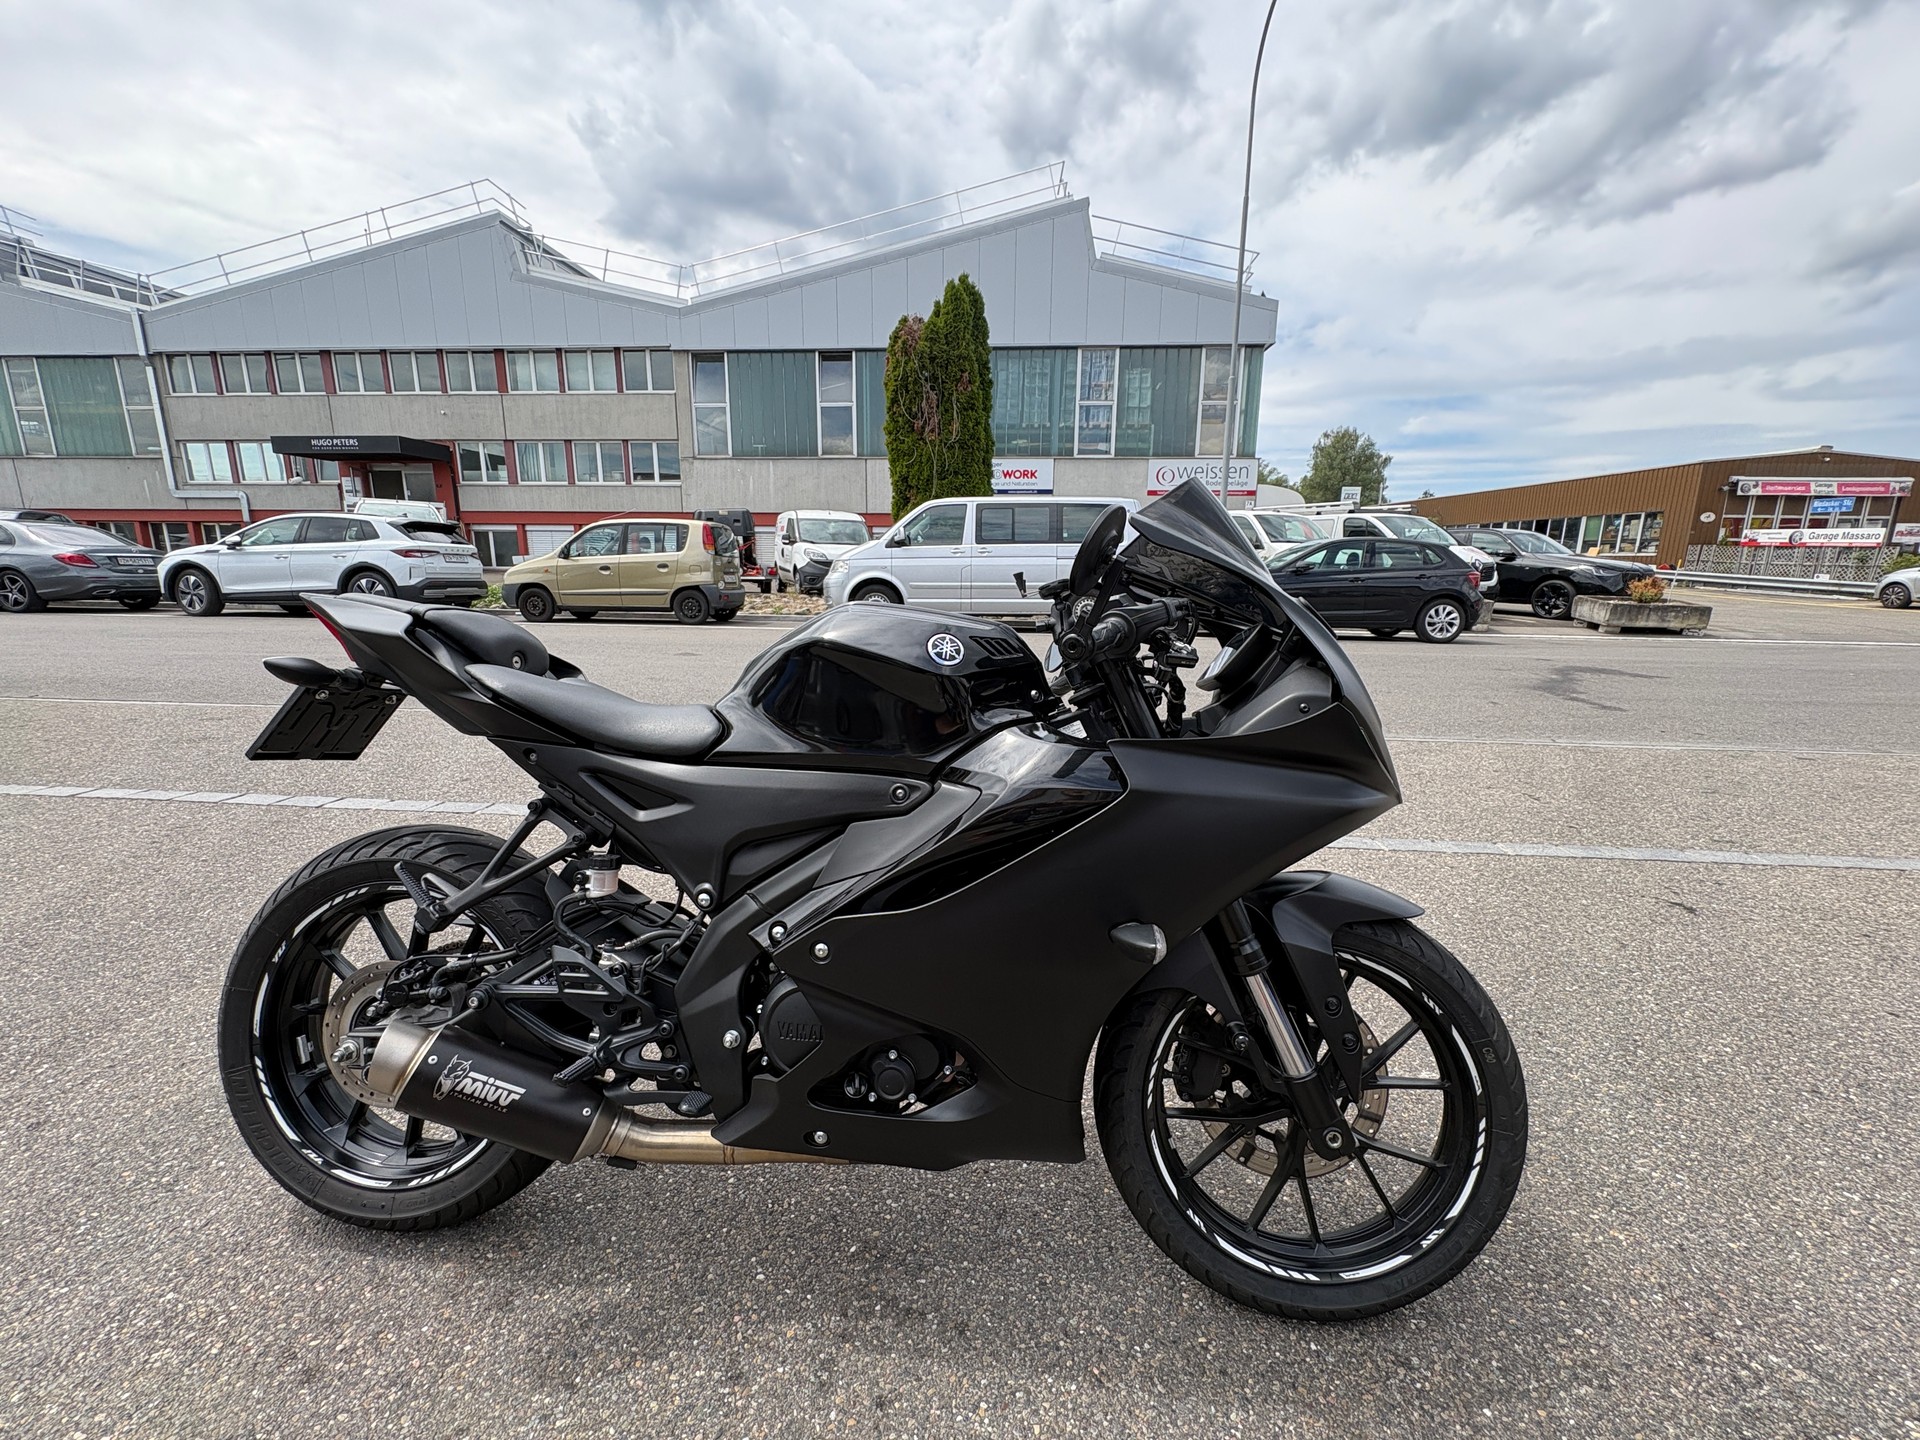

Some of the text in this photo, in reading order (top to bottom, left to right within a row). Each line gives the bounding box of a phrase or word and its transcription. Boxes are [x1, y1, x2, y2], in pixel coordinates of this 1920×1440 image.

[991, 469, 1038, 480] DWORK
[1177, 463, 1249, 479] weissen
[1808, 531, 1881, 541] Garage Massaro
[449, 1092, 508, 1113] ITALIAN STYLE
